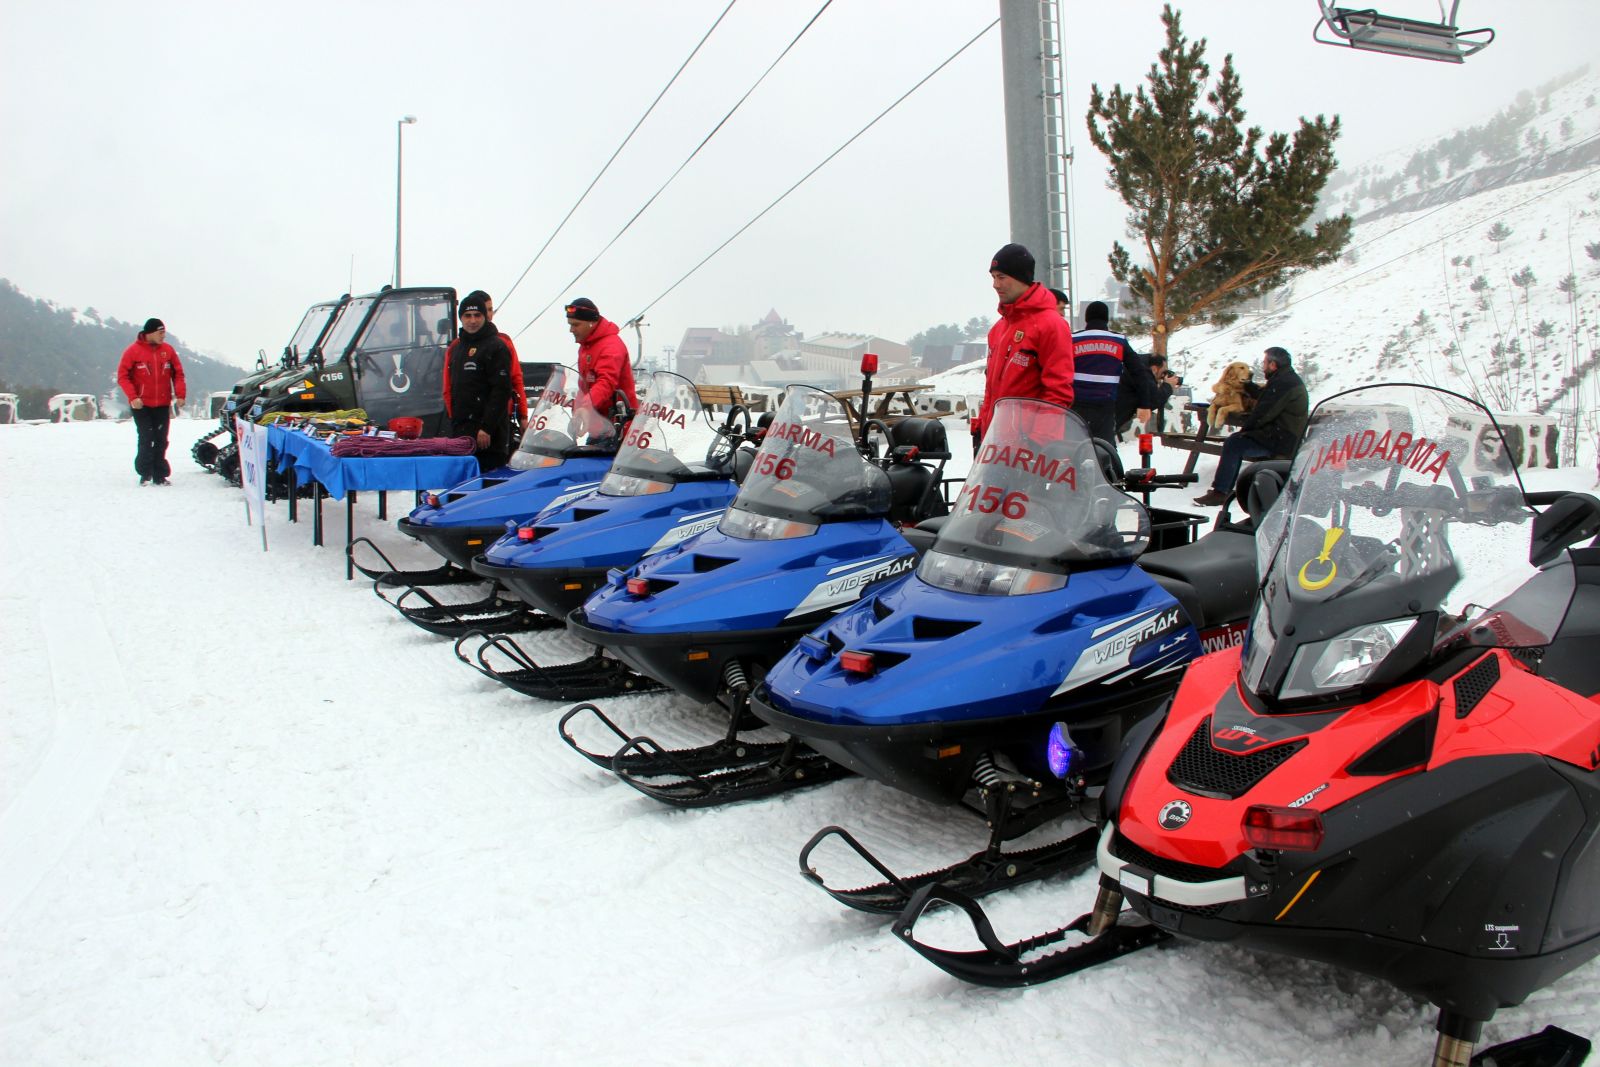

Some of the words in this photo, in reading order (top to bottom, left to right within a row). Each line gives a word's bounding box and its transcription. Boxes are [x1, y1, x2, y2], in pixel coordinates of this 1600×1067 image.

[1074, 342, 1118, 355] JANDARMA
[754, 452, 796, 481] 156
[1310, 430, 1450, 483] JANDARMA
[967, 484, 1029, 520] 156
[827, 557, 914, 596] WIDETRAK
[1094, 609, 1179, 664] WIDETRAK
[1159, 631, 1189, 653] LX
[1214, 728, 1269, 746] WT
